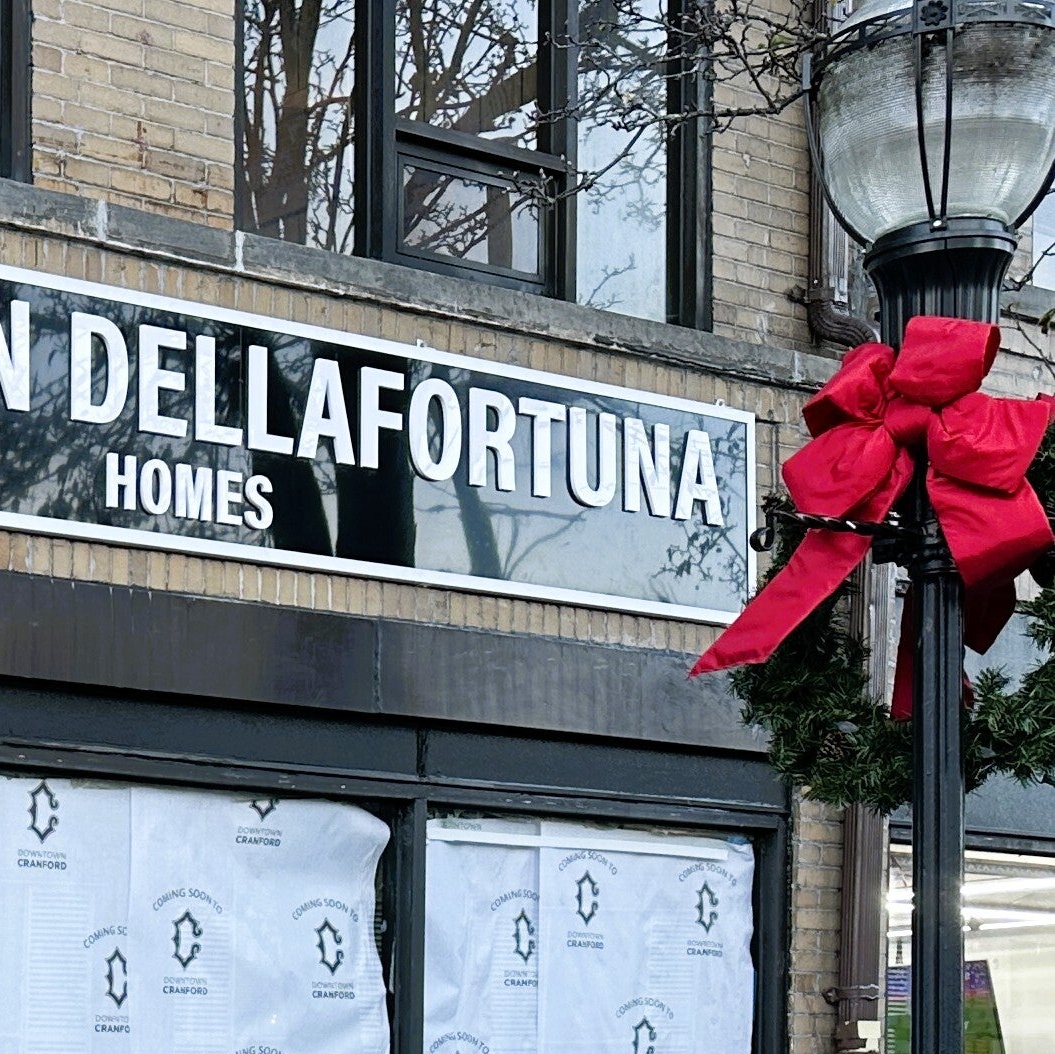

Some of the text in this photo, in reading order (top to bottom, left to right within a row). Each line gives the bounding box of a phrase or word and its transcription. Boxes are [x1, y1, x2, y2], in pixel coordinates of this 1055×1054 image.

[69, 311, 724, 527] DELLAFORTUNA
[105, 451, 274, 530] HOMES
[236, 836, 281, 847] CRANFORD
[17, 859, 67, 871] CRANFORD
[152, 888, 222, 915] COMING SOON TO
[292, 898, 358, 923] COMING SOON TO
[504, 979, 538, 987] CRANFO
[163, 986, 208, 995] CRANFORD
[312, 990, 355, 1000] CRANFORD
[95, 1023, 130, 1033] CRANFO
